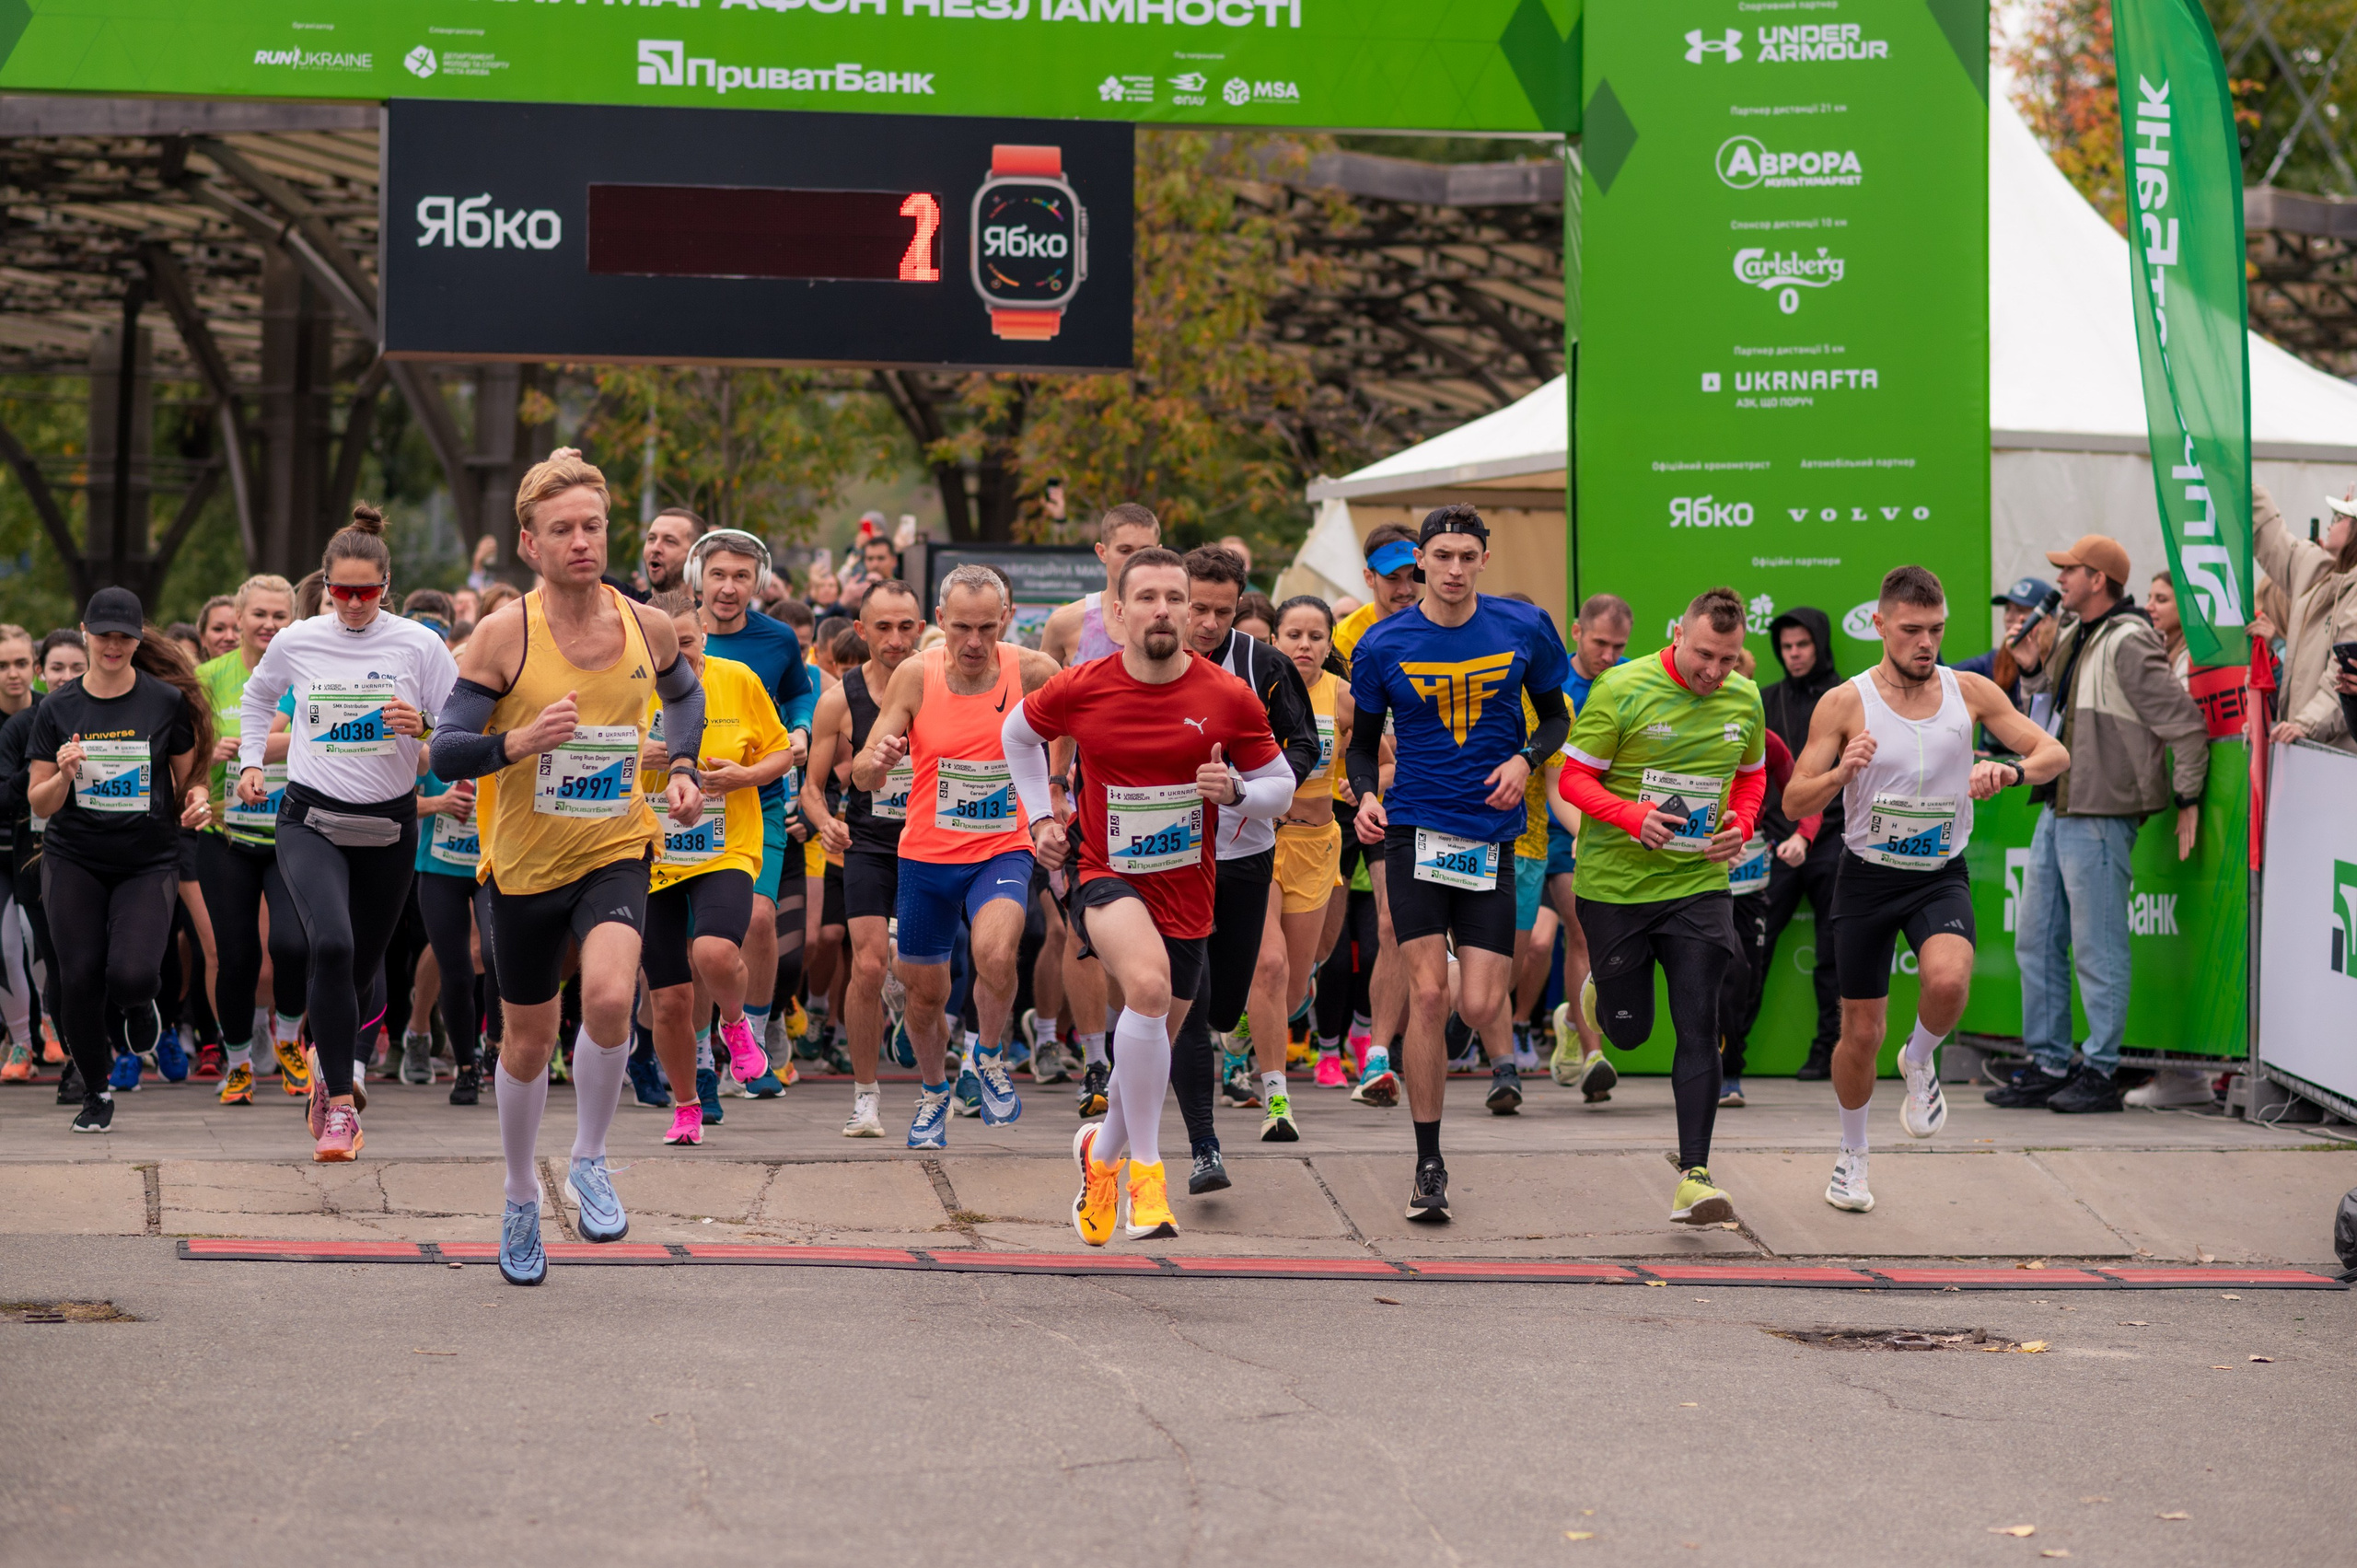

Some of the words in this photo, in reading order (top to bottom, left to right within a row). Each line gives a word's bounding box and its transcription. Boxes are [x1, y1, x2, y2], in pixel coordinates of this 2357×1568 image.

[1758, 24, 1861, 45] UNDER
[1757, 41, 1889, 63] ARMOUR
[686, 58, 936, 94] ПриватБанк
[1253, 81, 1300, 99] MSA
[1820, 103, 1832, 113] 21
[415, 192, 563, 250] Ябко
[1821, 217, 1833, 227] 10
[983, 225, 1068, 260] Ябко
[1733, 246, 1845, 288] Carlsberg
[1778, 286, 1800, 315] 0
[1824, 343, 1830, 354] 5
[1735, 368, 1879, 391] UKRNAFTA
[1760, 397, 1778, 408] ЩО
[1780, 396, 1815, 407] ПОРУЧ
[1669, 494, 1754, 528] Ябко
[1787, 506, 1931, 522] VOLVO
[85, 729, 135, 740] universe
[330, 722, 375, 741] 6038
[92, 779, 132, 797] 5453
[561, 775, 613, 799] 5997
[1167, 788, 1198, 796] UKRNAFT
[890, 792, 909, 807] 60
[957, 798, 1000, 819] 5813
[564, 805, 613, 814] ПриватБанк
[959, 821, 1002, 830] ПриватБанк
[665, 831, 705, 851] 5338
[1131, 831, 1181, 856] 5235
[1887, 834, 1933, 856] 5625
[1137, 857, 1184, 870] ПриватБанк
[1435, 851, 1478, 875] 5258
[1888, 857, 1932, 867] ПриватБанк
[1438, 873, 1479, 888] ПриватБанк
